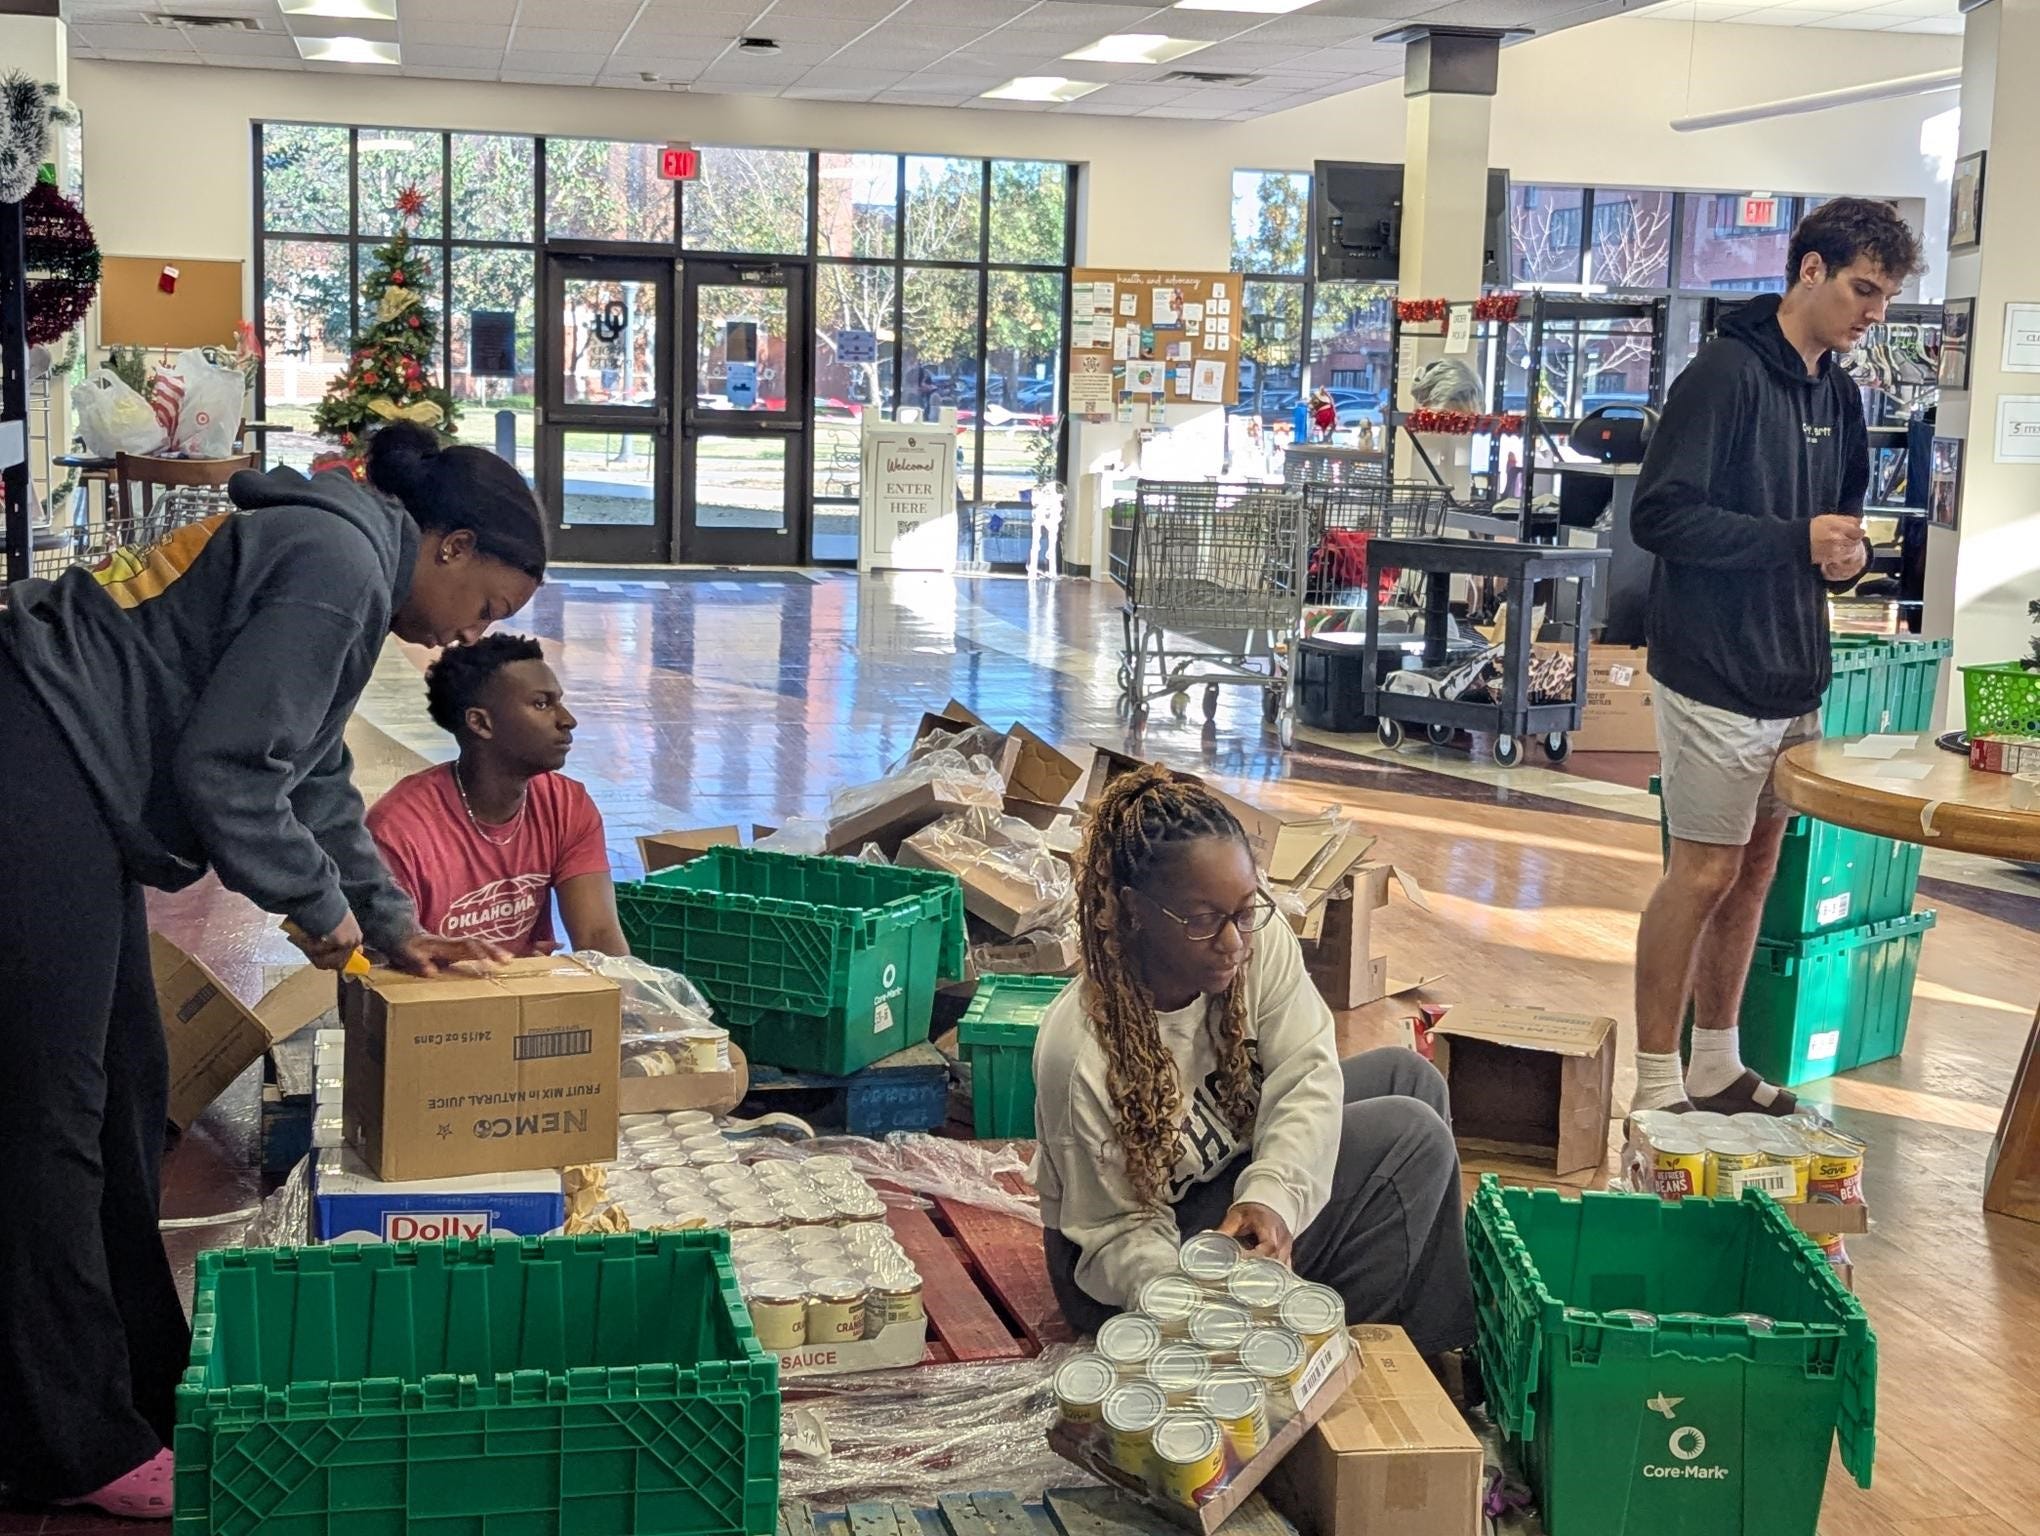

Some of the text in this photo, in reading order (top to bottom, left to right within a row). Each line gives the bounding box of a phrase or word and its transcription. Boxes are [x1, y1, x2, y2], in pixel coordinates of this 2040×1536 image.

[1746, 201, 1775, 224] EXIT
[1117, 274, 1201, 290] health and advocacy
[887, 458, 934, 474] Welcome!
[887, 483, 932, 494] ENTER
[890, 502, 927, 513] HERE
[448, 894, 536, 929] OKLAHOMA
[414, 1031, 492, 1045] 24/15 oz Cans
[542, 1087, 564, 1099] MIX
[565, 1083, 600, 1098] FRUIT
[428, 1097, 462, 1110] JUICE
[467, 1091, 526, 1105] NATURAL
[473, 1109, 588, 1139] NEMCO
[1819, 1165, 1847, 1176] Save
[1655, 1179, 1688, 1193] BEANS
[391, 1216, 484, 1241] Dolly
[781, 1351, 838, 1369] SAUCE
